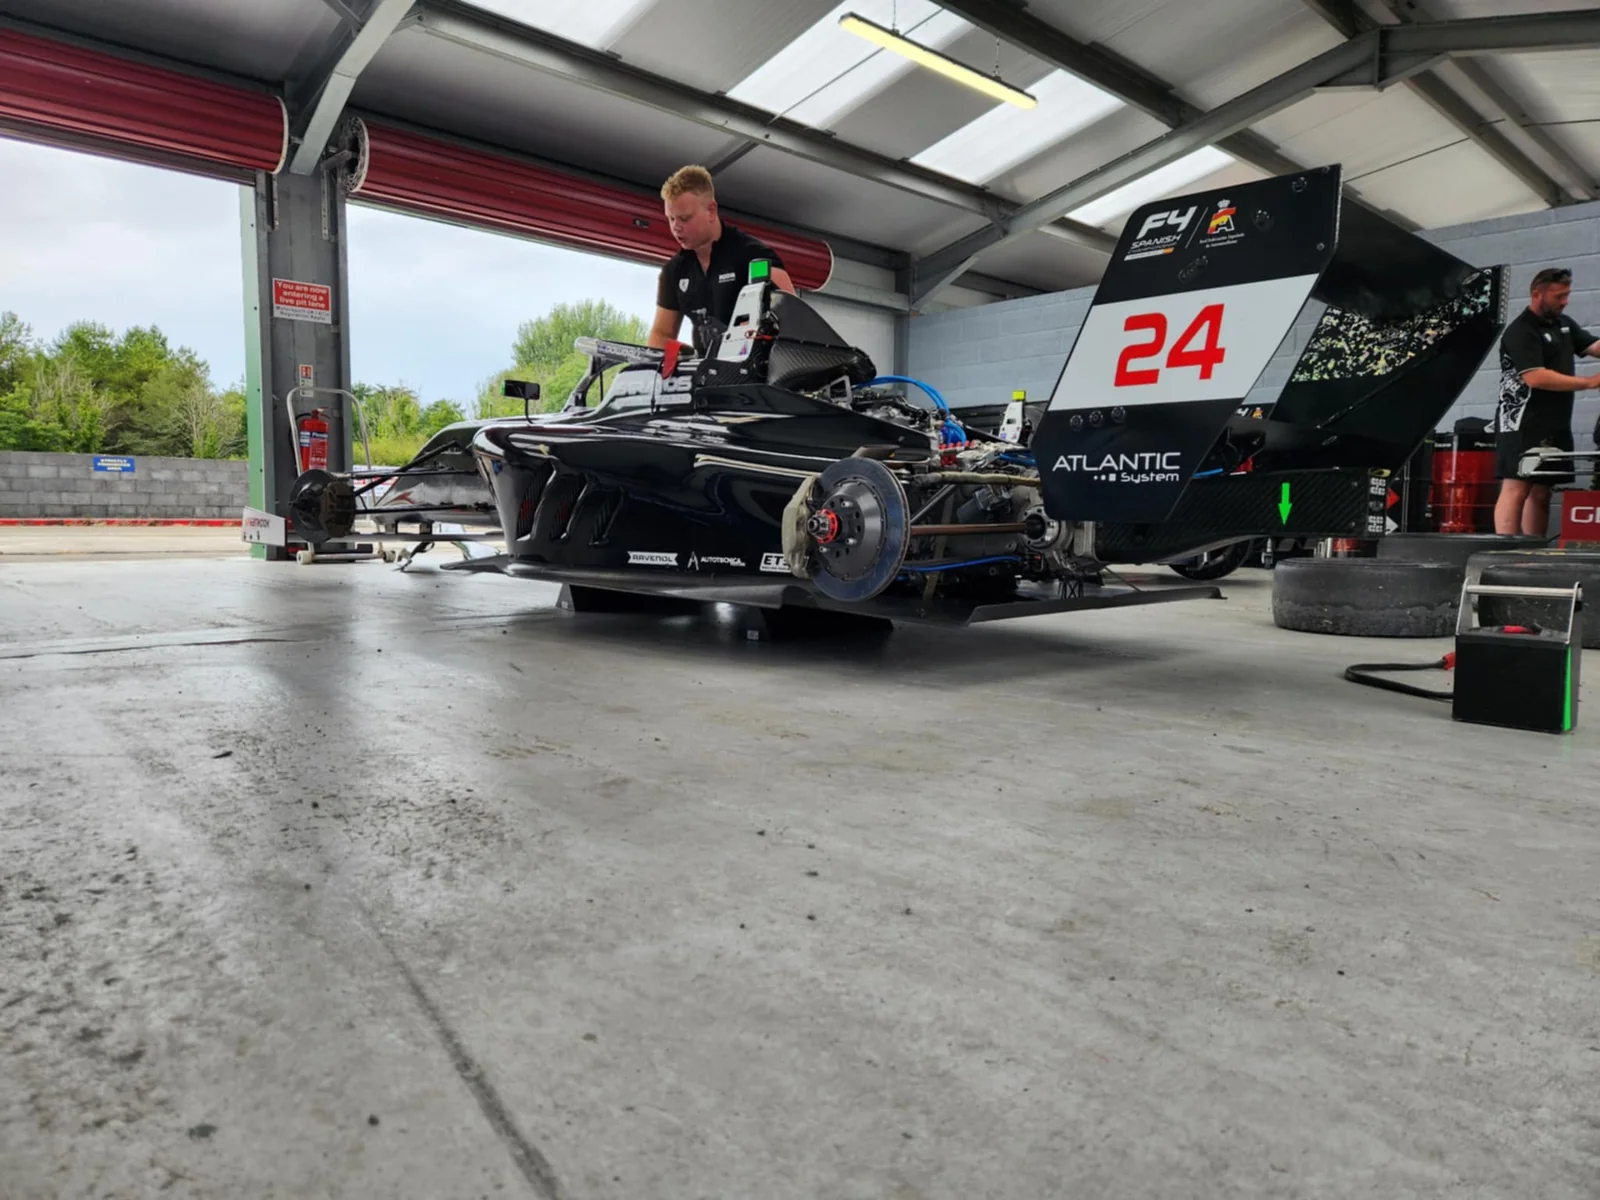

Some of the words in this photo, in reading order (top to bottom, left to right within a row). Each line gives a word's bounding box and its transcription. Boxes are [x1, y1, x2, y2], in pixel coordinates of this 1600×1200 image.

[1136, 205, 1198, 240] F4
[1130, 233, 1182, 250] SPANISH
[276, 282, 294, 290] You
[279, 295, 295, 305] live
[308, 300, 326, 308] lane
[283, 290, 318, 302] entering
[1114, 303, 1226, 387] 24
[1052, 452, 1181, 472] ATLANTIC
[1120, 471, 1180, 484] System
[1571, 506, 1600, 523] G
[632, 554, 674, 563] RAVENOL
